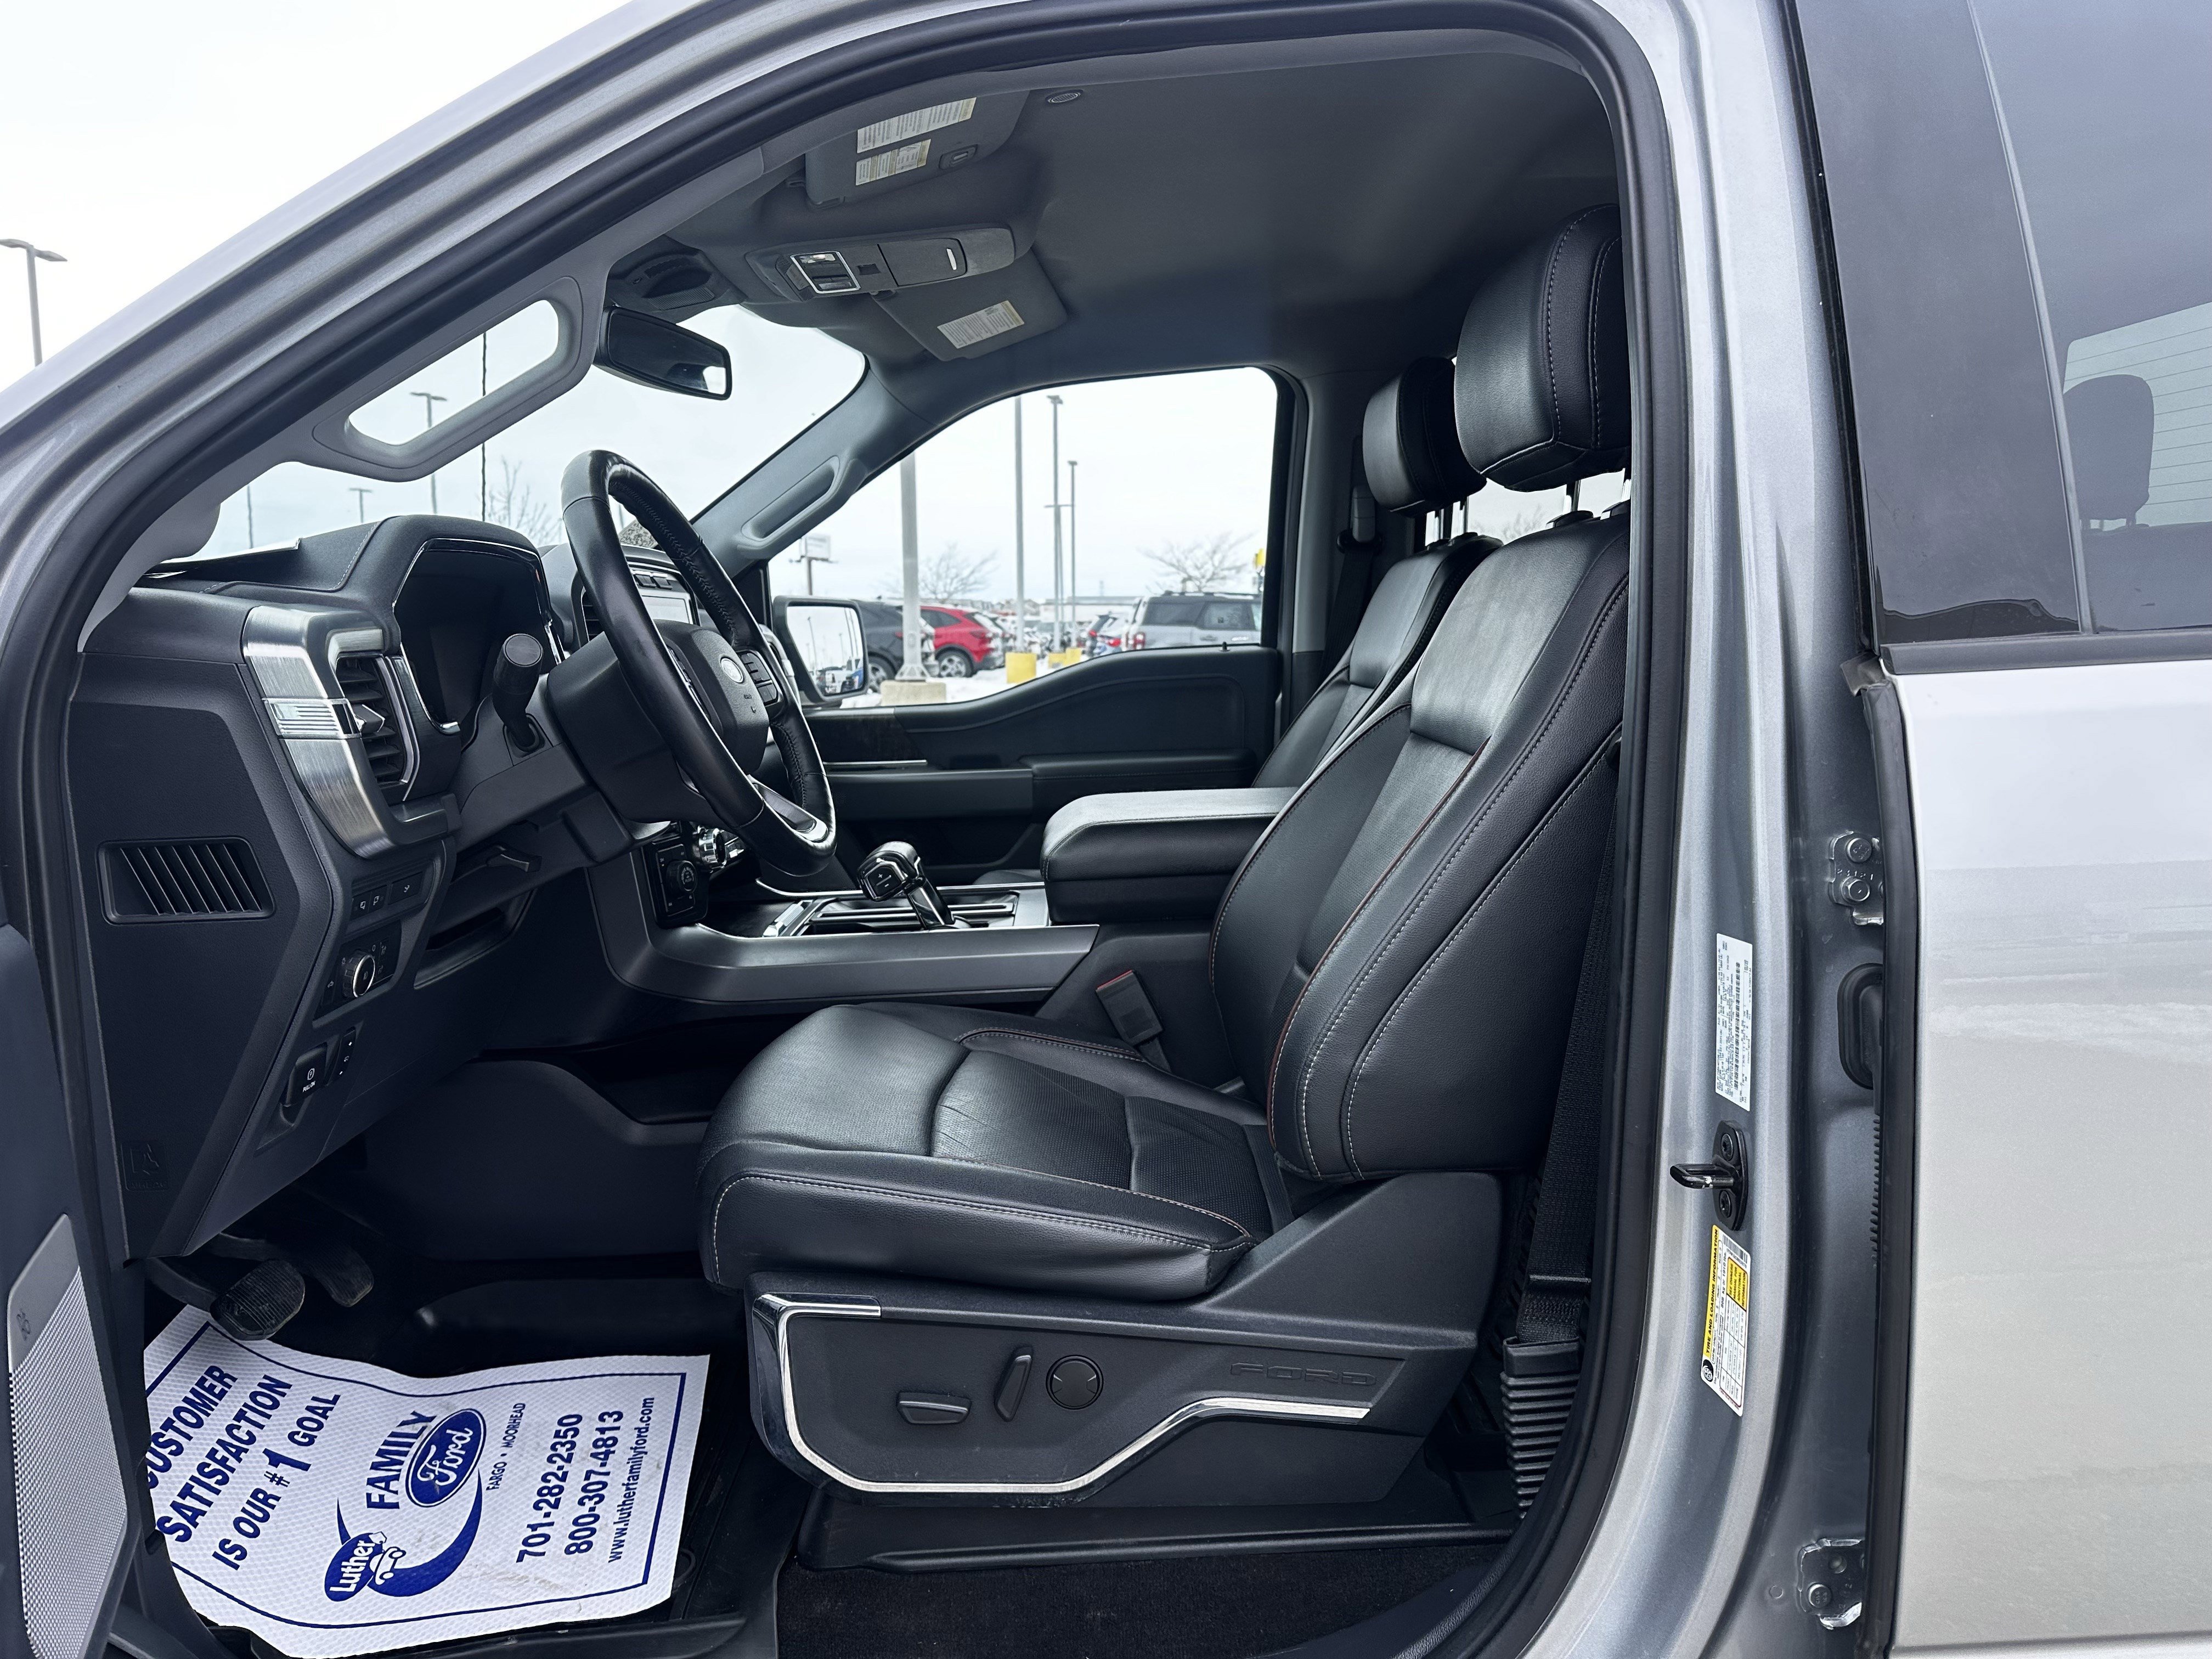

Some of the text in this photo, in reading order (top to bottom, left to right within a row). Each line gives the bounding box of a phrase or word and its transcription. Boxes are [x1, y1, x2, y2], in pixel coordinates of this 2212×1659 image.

[1231, 1362, 1376, 1386] FORD
[156, 1374, 292, 1542] SATISFACTION
[212, 1538, 247, 1570] IS
[233, 1488, 281, 1538] OUR
[287, 1394, 341, 1447] GOAL
[366, 1410, 437, 1509] FAMILY
[417, 1427, 473, 1486] Ford
[486, 1403, 526, 1491] FARGO MOORHEAD
[516, 1414, 583, 1563] 701-282-2350
[565, 1410, 624, 1555] 800-307-4813
[608, 1397, 654, 1563] www.lutherfamilyford.com
[330, 1540, 377, 1592] Luther
